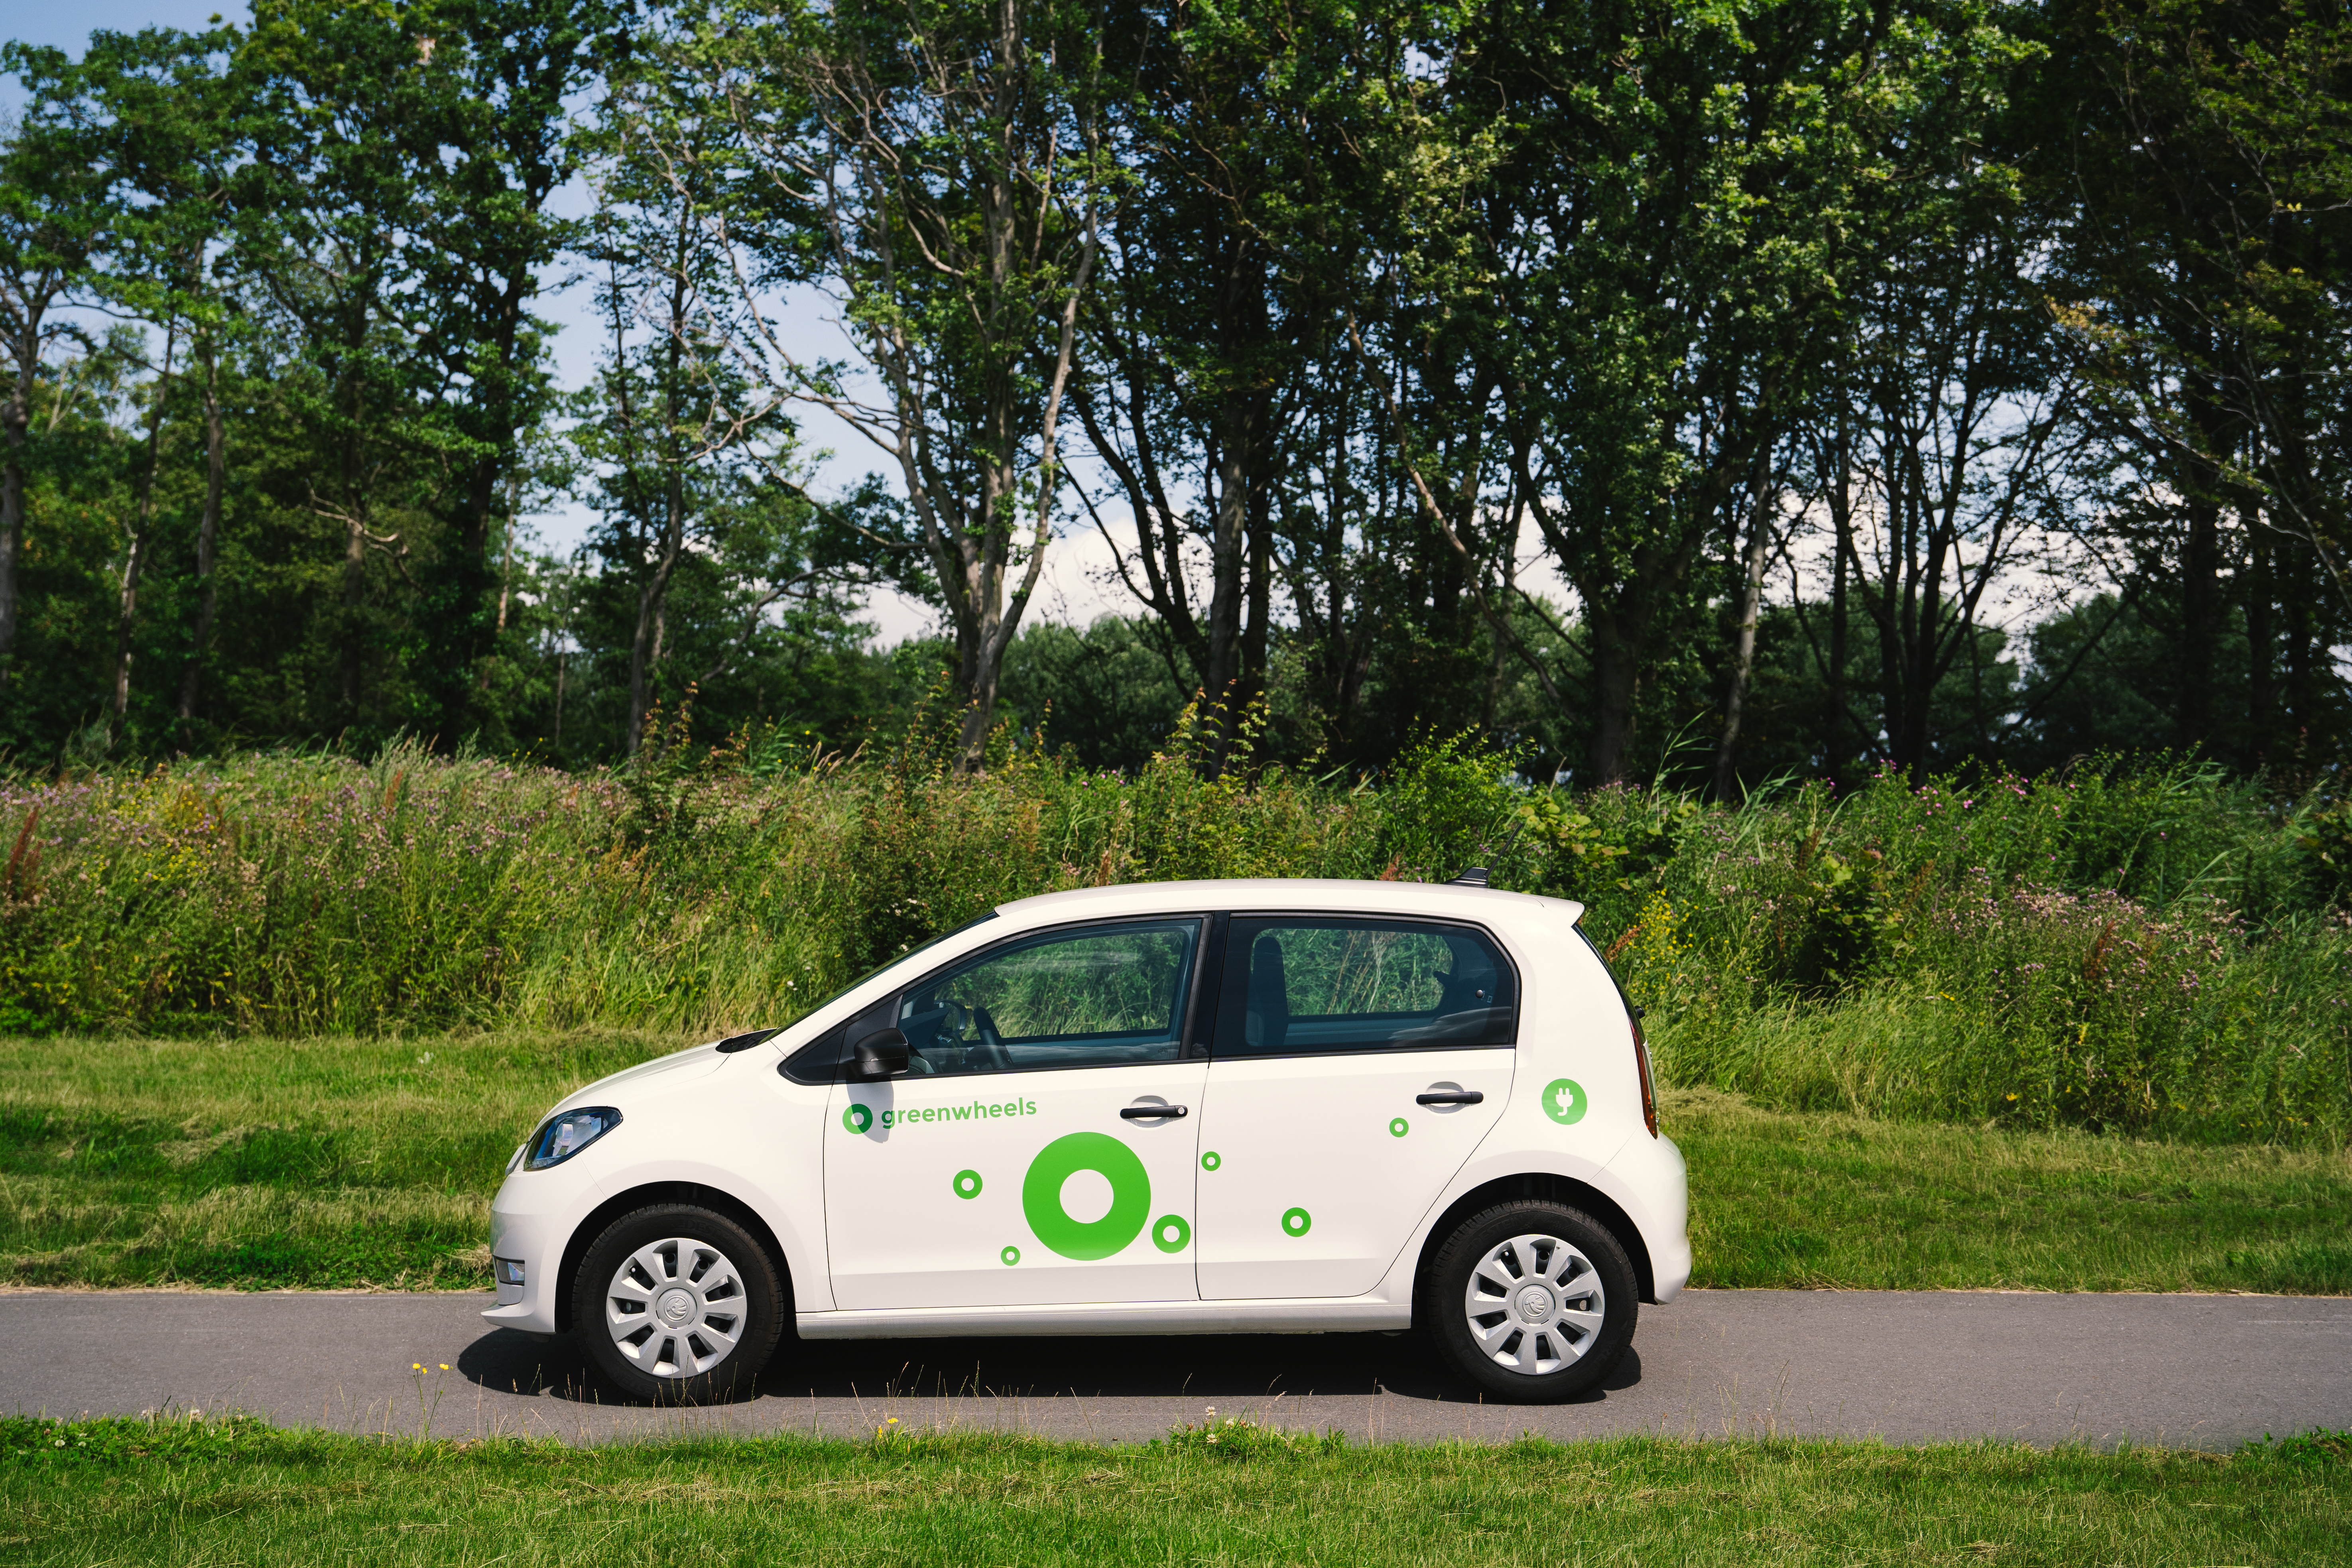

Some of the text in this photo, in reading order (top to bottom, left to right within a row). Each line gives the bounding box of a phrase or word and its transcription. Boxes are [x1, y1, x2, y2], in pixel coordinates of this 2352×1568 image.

[881, 1097, 1036, 1129] greenwheels
[1453, 1215, 1524, 1271] VREDESTEIN
[585, 1262, 606, 1319] QUATRAC
[1547, 1339, 1618, 1394] VREDESTEIN
